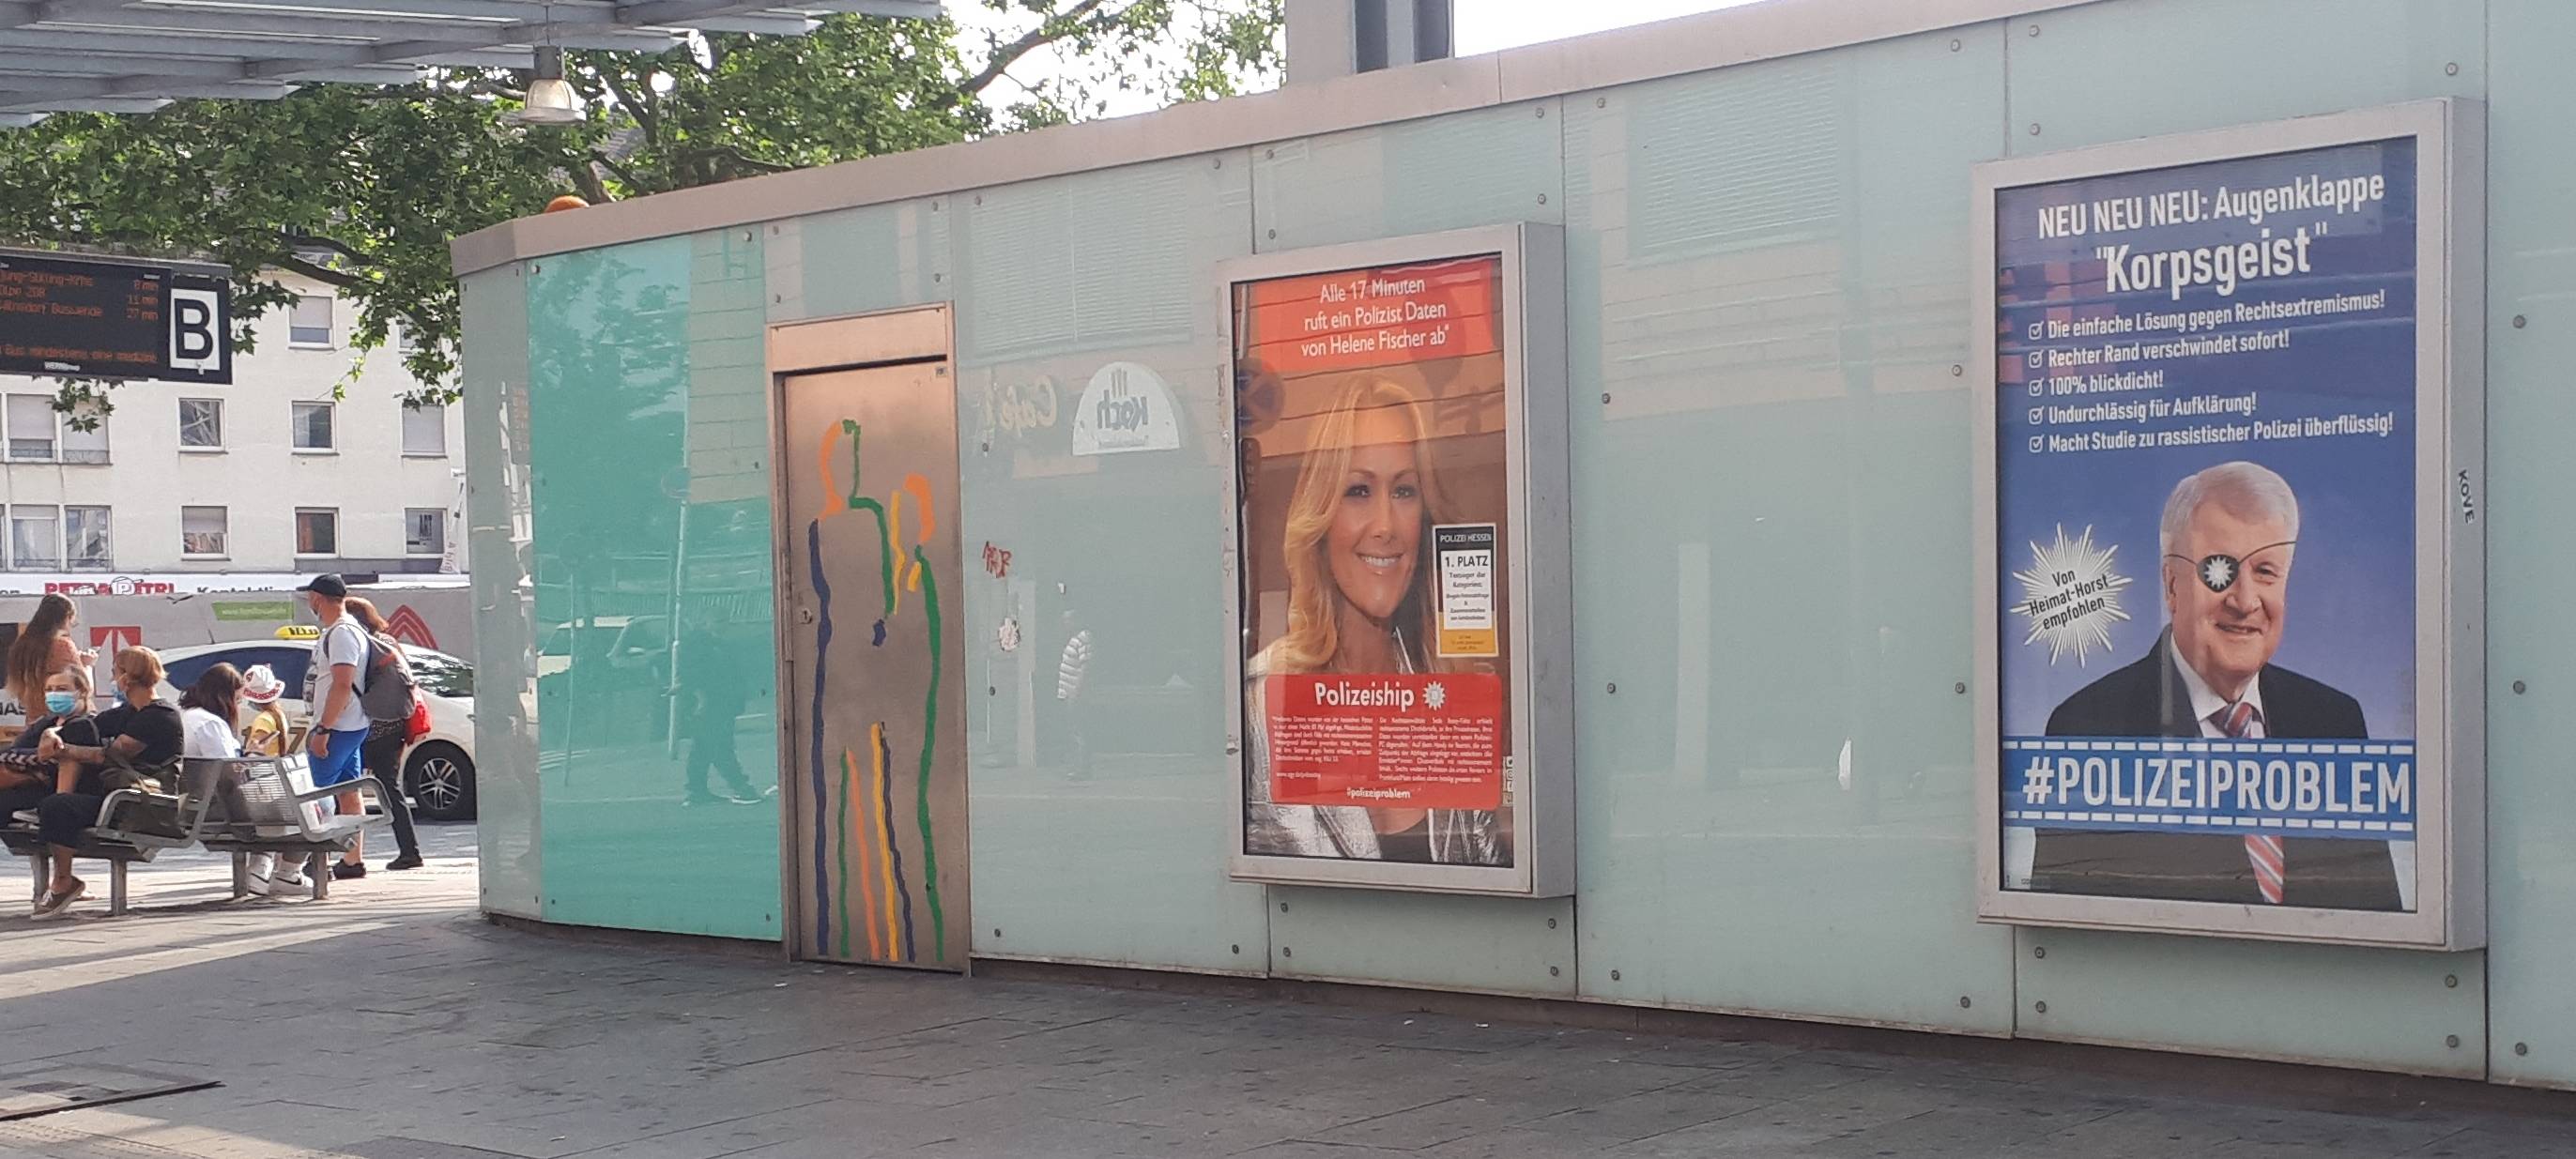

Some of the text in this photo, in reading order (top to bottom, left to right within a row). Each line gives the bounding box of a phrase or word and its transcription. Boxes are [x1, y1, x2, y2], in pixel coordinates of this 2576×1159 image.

[2038, 174, 2384, 238] NEU NEU NEU: Augenklappe
[2095, 221, 2327, 299] "Korpsgeist"
[1320, 279, 1425, 303] Alle 17 Minuten
[175, 298, 214, 359] B
[1305, 301, 1447, 332] ruft ein Polizist Daten
[2048, 289, 2384, 339] Die einfache Lösung gegen Rechtsextremismus!
[1301, 342, 1326, 357] von
[1330, 335, 1374, 355] Helene
[1379, 328, 1426, 349] Fischer
[2048, 330, 2290, 368] Rechter Rand verschwindet sofort!
[2048, 370, 2164, 396] 100% blickdicht!
[2048, 392, 2257, 425] Undurchlässig für Aufklärung!
[2048, 412, 2393, 453] Macht Studie zu rassistischer Polizei überflüssig!
[2459, 469, 2475, 524] KOVE
[1445, 556, 1489, 567] 1. PLATZ
[2051, 570, 2076, 587] Von
[2029, 573, 2108, 617] Heimat-Horst
[2043, 597, 2105, 630] empfohlen
[1314, 680, 1415, 712] Polizeiship
[2022, 755, 2410, 815] #POLIZEIPROBLEM
